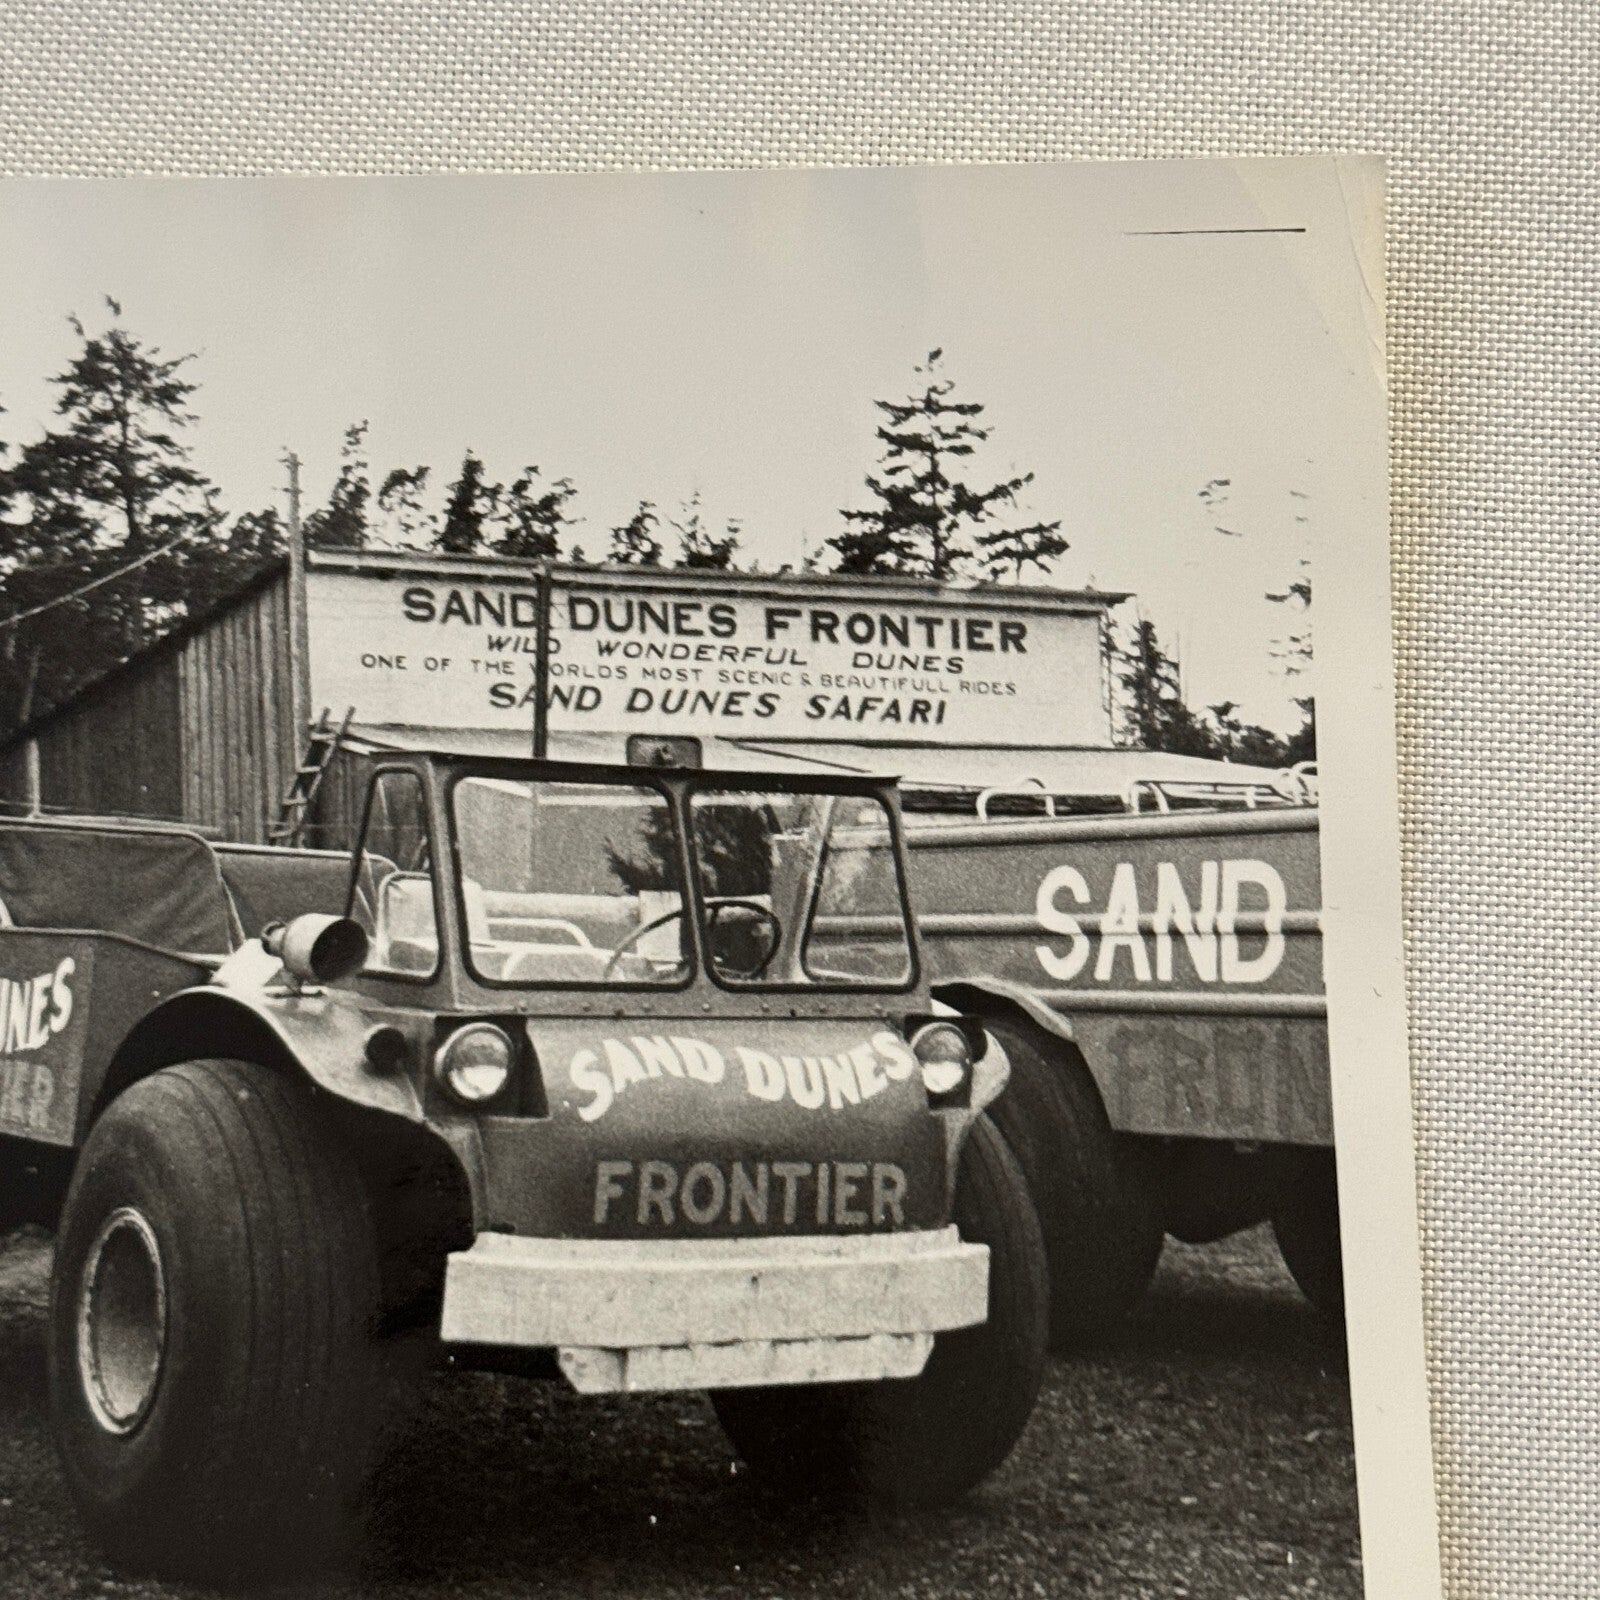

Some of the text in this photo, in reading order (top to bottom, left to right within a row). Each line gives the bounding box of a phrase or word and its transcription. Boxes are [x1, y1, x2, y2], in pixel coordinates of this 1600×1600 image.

[403, 587, 1029, 653] SAND DUNES FRONTIER
[360, 653, 408, 671] ONE
[424, 657, 452, 672] OF
[470, 658, 516, 676] THE
[642, 667, 702, 683] MOST
[718, 669, 794, 687] SCENIC
[821, 674, 951, 695] BEAUTIFULL
[959, 679, 1018, 697] RIDES
[487, 634, 966, 675] WILD WONDERFUL DUNES
[489, 682, 947, 726] SAND DUNES SAFARI
[1036, 859, 1287, 984] SAND
[569, 1031, 914, 1123] SAND DUNES
[593, 1160, 907, 1226] FRONTIER
